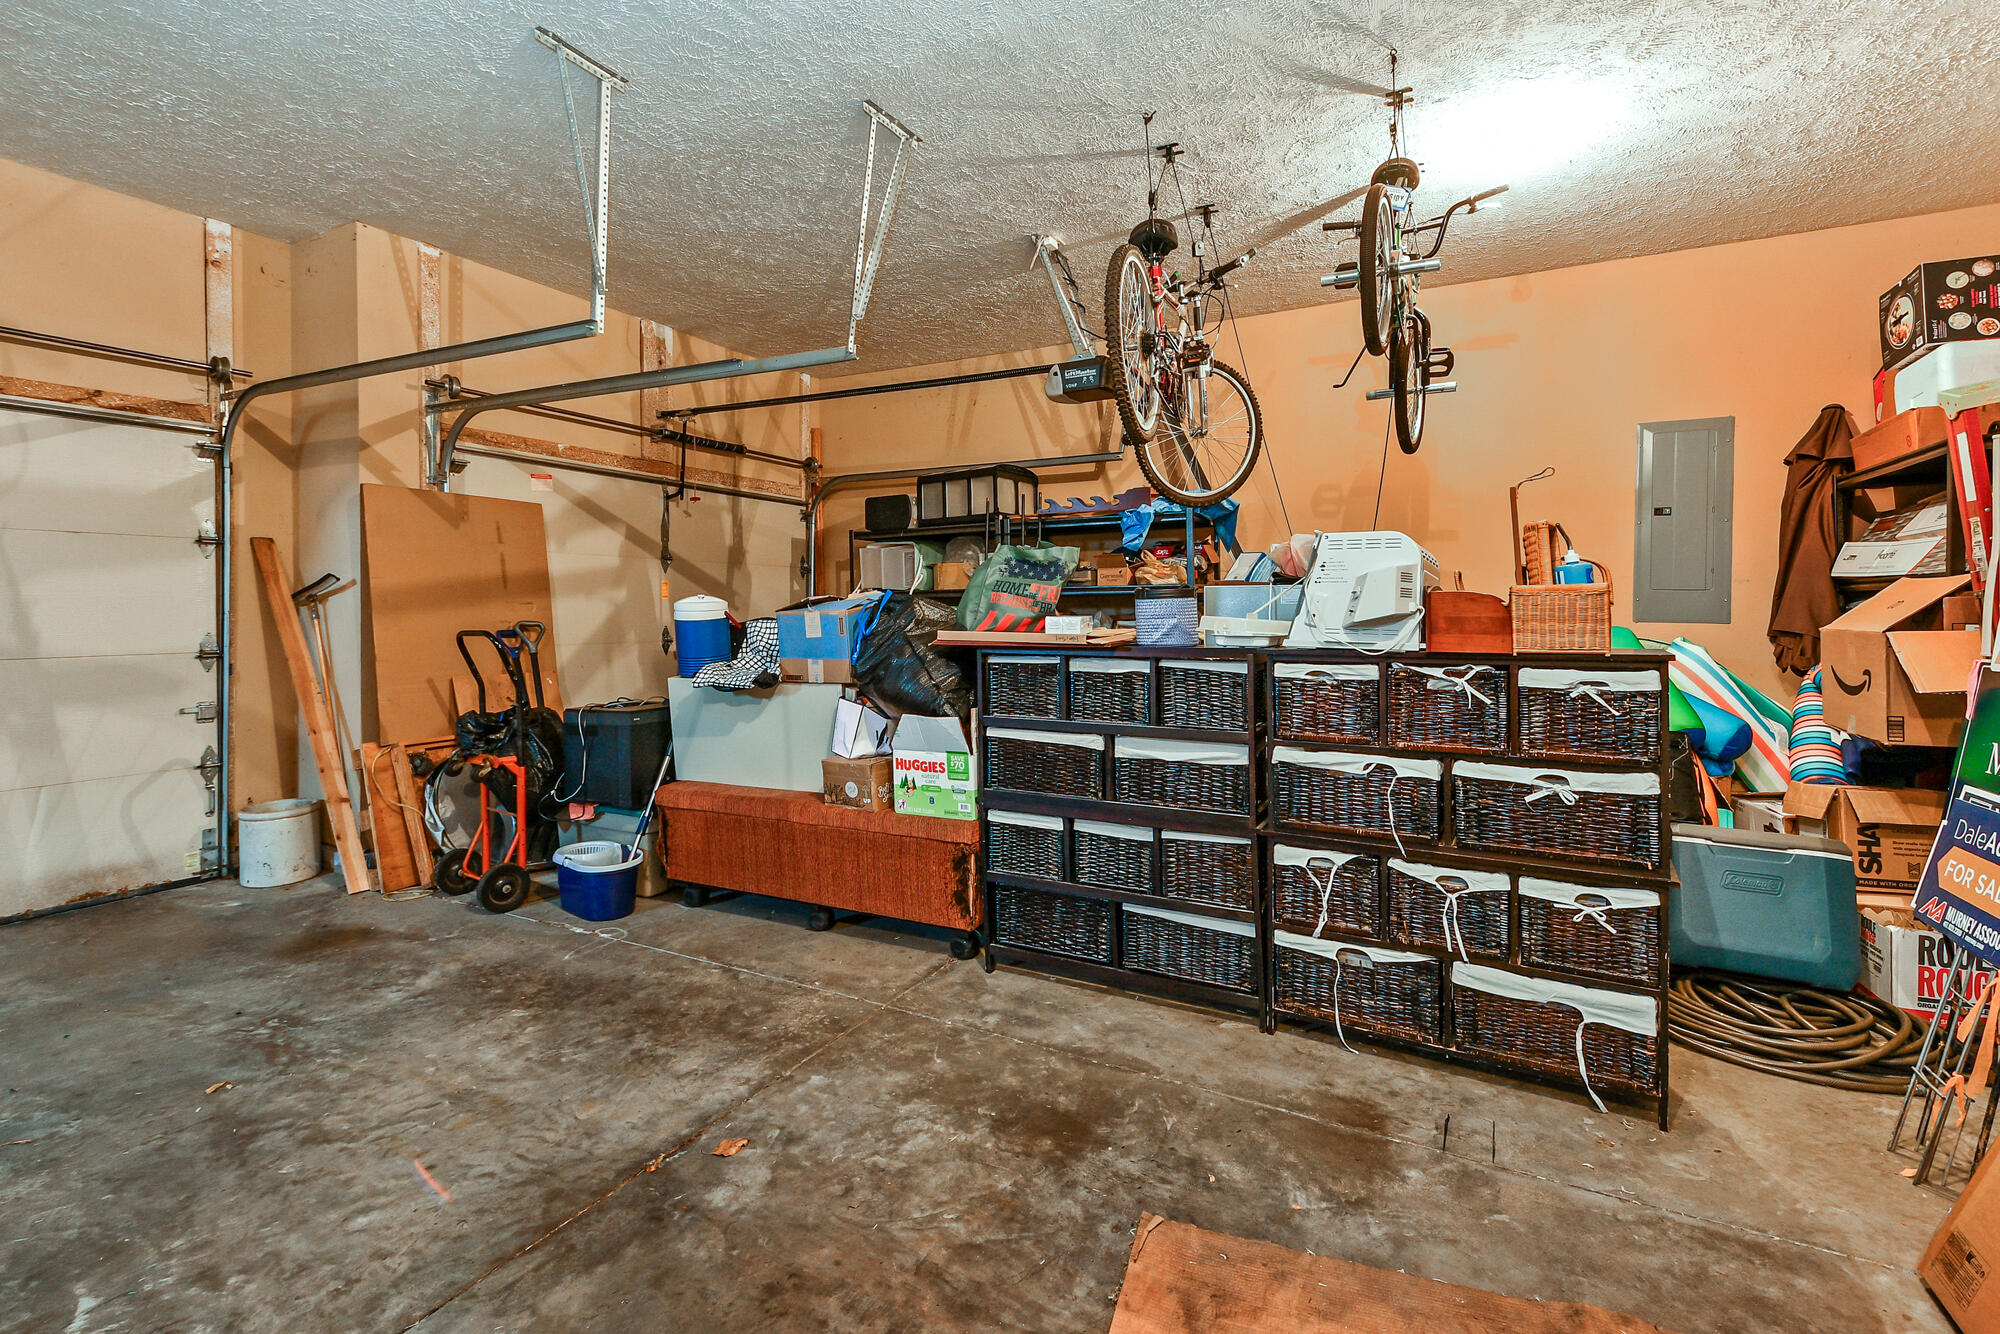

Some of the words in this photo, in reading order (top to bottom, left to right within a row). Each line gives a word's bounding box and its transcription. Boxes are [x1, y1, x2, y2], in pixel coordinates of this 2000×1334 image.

[992, 580, 1031, 597] HOME
[1038, 584, 1061, 603] FR
[895, 758, 946, 774] HUGGIES
[1944, 859, 1974, 889] FOR
[1945, 906, 1977, 935] MURNEY
[1917, 1002, 1950, 1011] ORGAC
